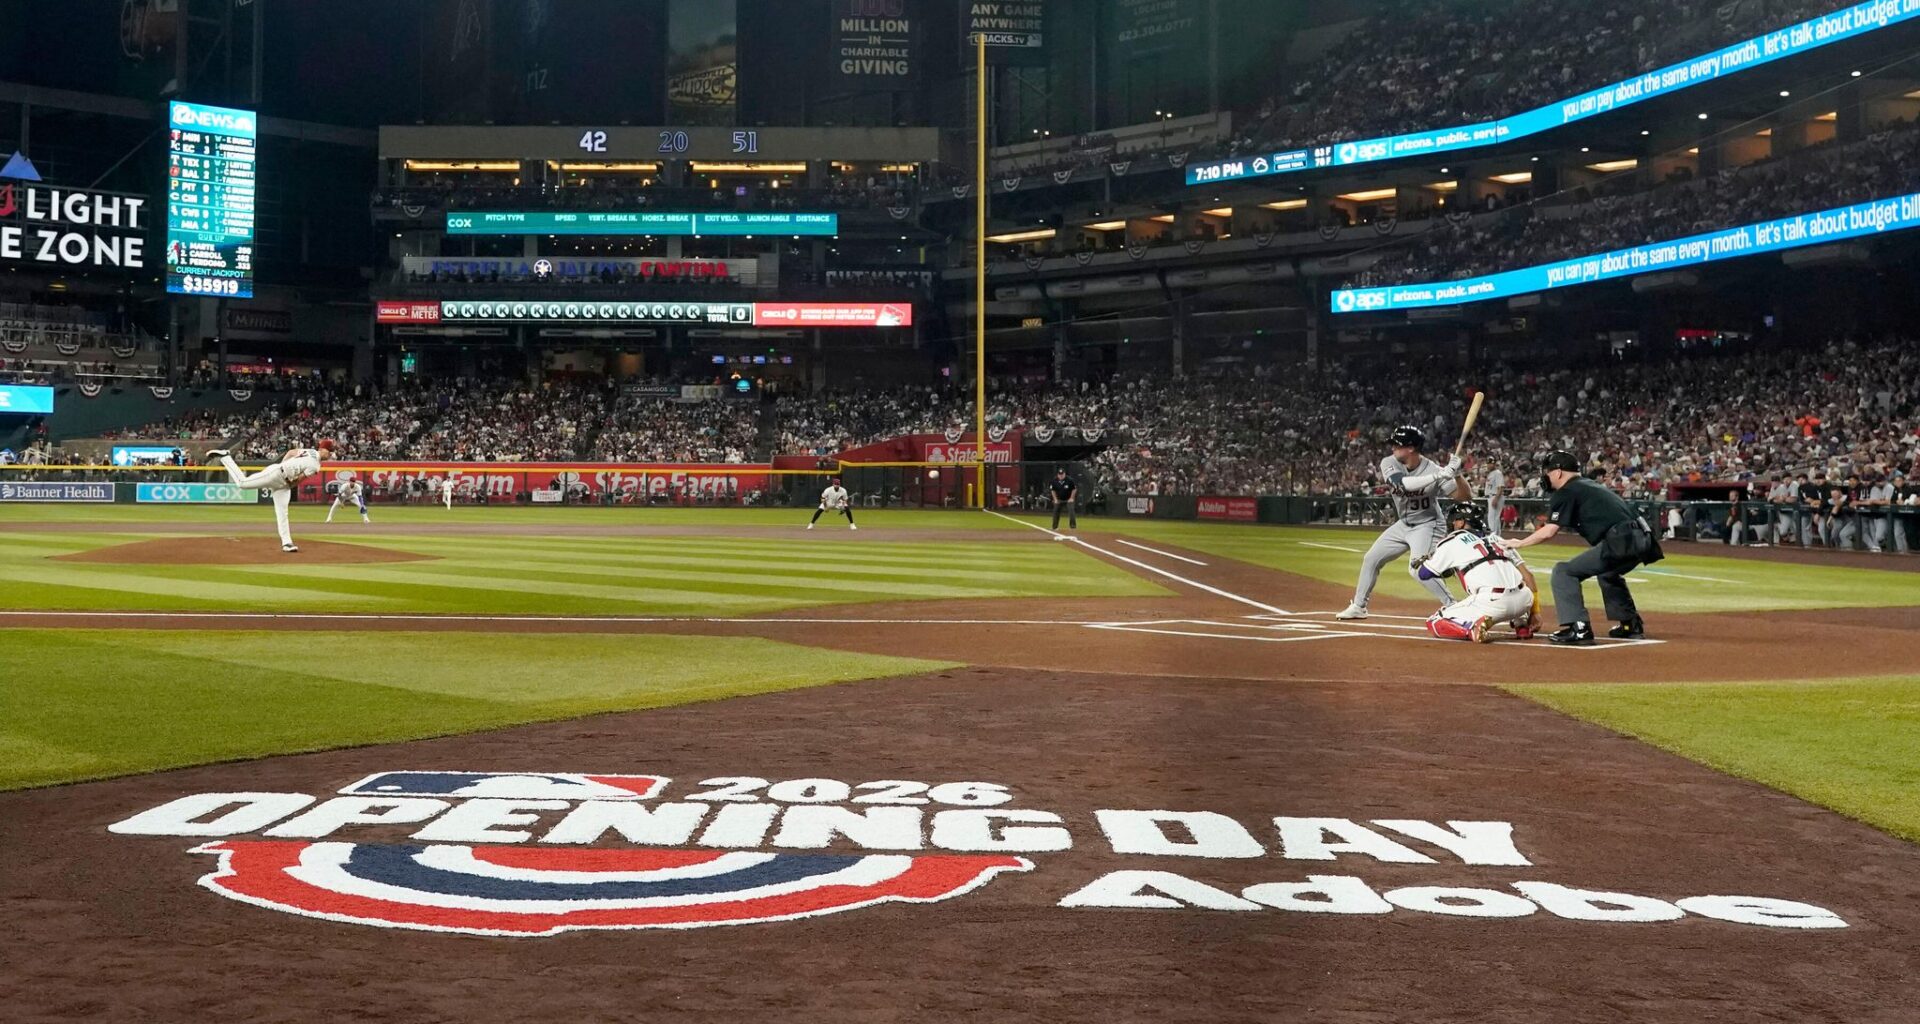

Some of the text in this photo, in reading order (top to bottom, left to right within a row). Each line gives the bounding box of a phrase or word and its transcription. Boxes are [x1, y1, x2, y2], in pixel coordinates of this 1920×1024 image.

[971, 4, 1042, 16] ANY GAME
[841, 19, 909, 33] MILLION
[971, 18, 1042, 30] ANYWHERE
[1764, 0, 1900, 56] let's talk about budget
[868, 35, 881, 44] IN
[841, 47, 909, 57] CHARITABLE
[841, 59, 909, 75] GIVING
[1563, 43, 1761, 123] you can pay about the same every month.
[182, 131, 199, 142] MIN
[579, 131, 607, 152] 42
[657, 131, 689, 152] 20
[732, 131, 758, 152] 51
[182, 144, 194, 152] KC
[1358, 143, 1387, 160] aps
[182, 157, 199, 167] TEX
[182, 168, 199, 178] BAL
[1195, 162, 1244, 181] 7:10 PM
[182, 182, 196, 191] PIT
[181, 193, 197, 203] CIN
[27, 188, 144, 228] LIGHT
[181, 207, 199, 217] CWS
[181, 219, 198, 229] MIA
[448, 219, 471, 228] COX
[507, 214, 525, 222] TYPE
[555, 214, 576, 222] SPEED
[1756, 223, 1781, 246] let's
[1783, 216, 1807, 241] talk
[1810, 213, 1847, 236] about
[1850, 201, 1899, 231] budget
[36, 230, 144, 267] ZONE
[189, 250, 222, 259] CARROLL
[189, 258, 226, 267] PERDOMO
[1547, 227, 1752, 287] you can pay about the same every month.
[176, 266, 210, 275] CURRENT
[640, 261, 728, 277] CANTINA
[183, 274, 238, 295] $35919
[1356, 292, 1385, 309] aps
[411, 310, 438, 319] METER
[707, 314, 728, 322] TOTAL
[736, 308, 746, 320] 0
[17, 486, 105, 498] Banner Health
[151, 486, 243, 499] COX COX
[1410, 497, 1430, 510] 30
[684, 776, 1014, 806] 2026
[107, 791, 1534, 867] OPENING DAY
[1056, 869, 1850, 929] Adobe
